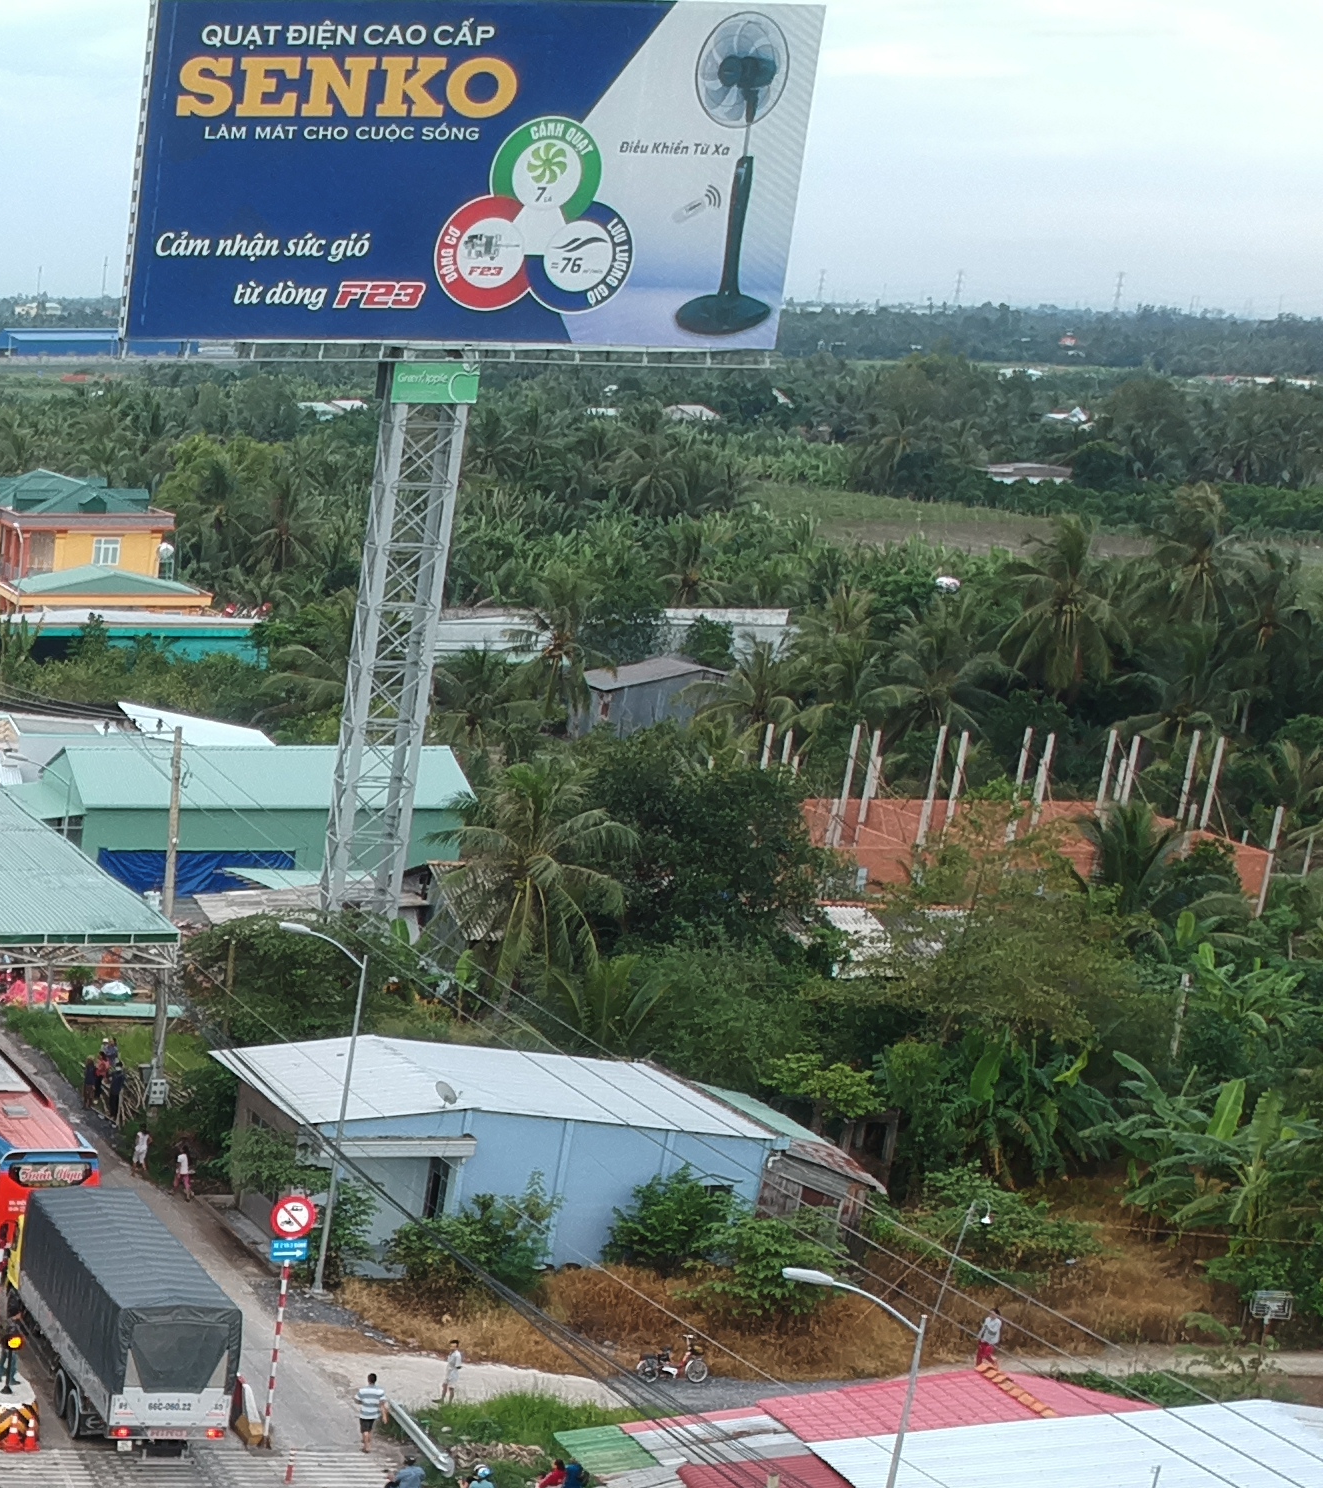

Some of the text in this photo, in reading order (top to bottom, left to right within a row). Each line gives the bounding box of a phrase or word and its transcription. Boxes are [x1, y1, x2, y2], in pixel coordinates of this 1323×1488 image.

[201, 18, 495, 50] QUẠT ĐIỆN CAO CẤP
[176, 56, 517, 119] SENKO
[204, 124, 246, 140] LÀM
[255, 124, 297, 140] MÁT
[304, 126, 348, 141] CHO
[355, 123, 414, 142] CUỘC
[530, 120, 564, 140] CÁNH
[619, 140, 649, 154] Điều
[651, 140, 689, 155] Khiển
[711, 143, 730, 156] Xa
[534, 187, 547, 203] 7
[155, 231, 371, 262] Cảm nhận sức gió
[467, 265, 504, 277] F23
[234, 280, 427, 311] từ dòng F23
